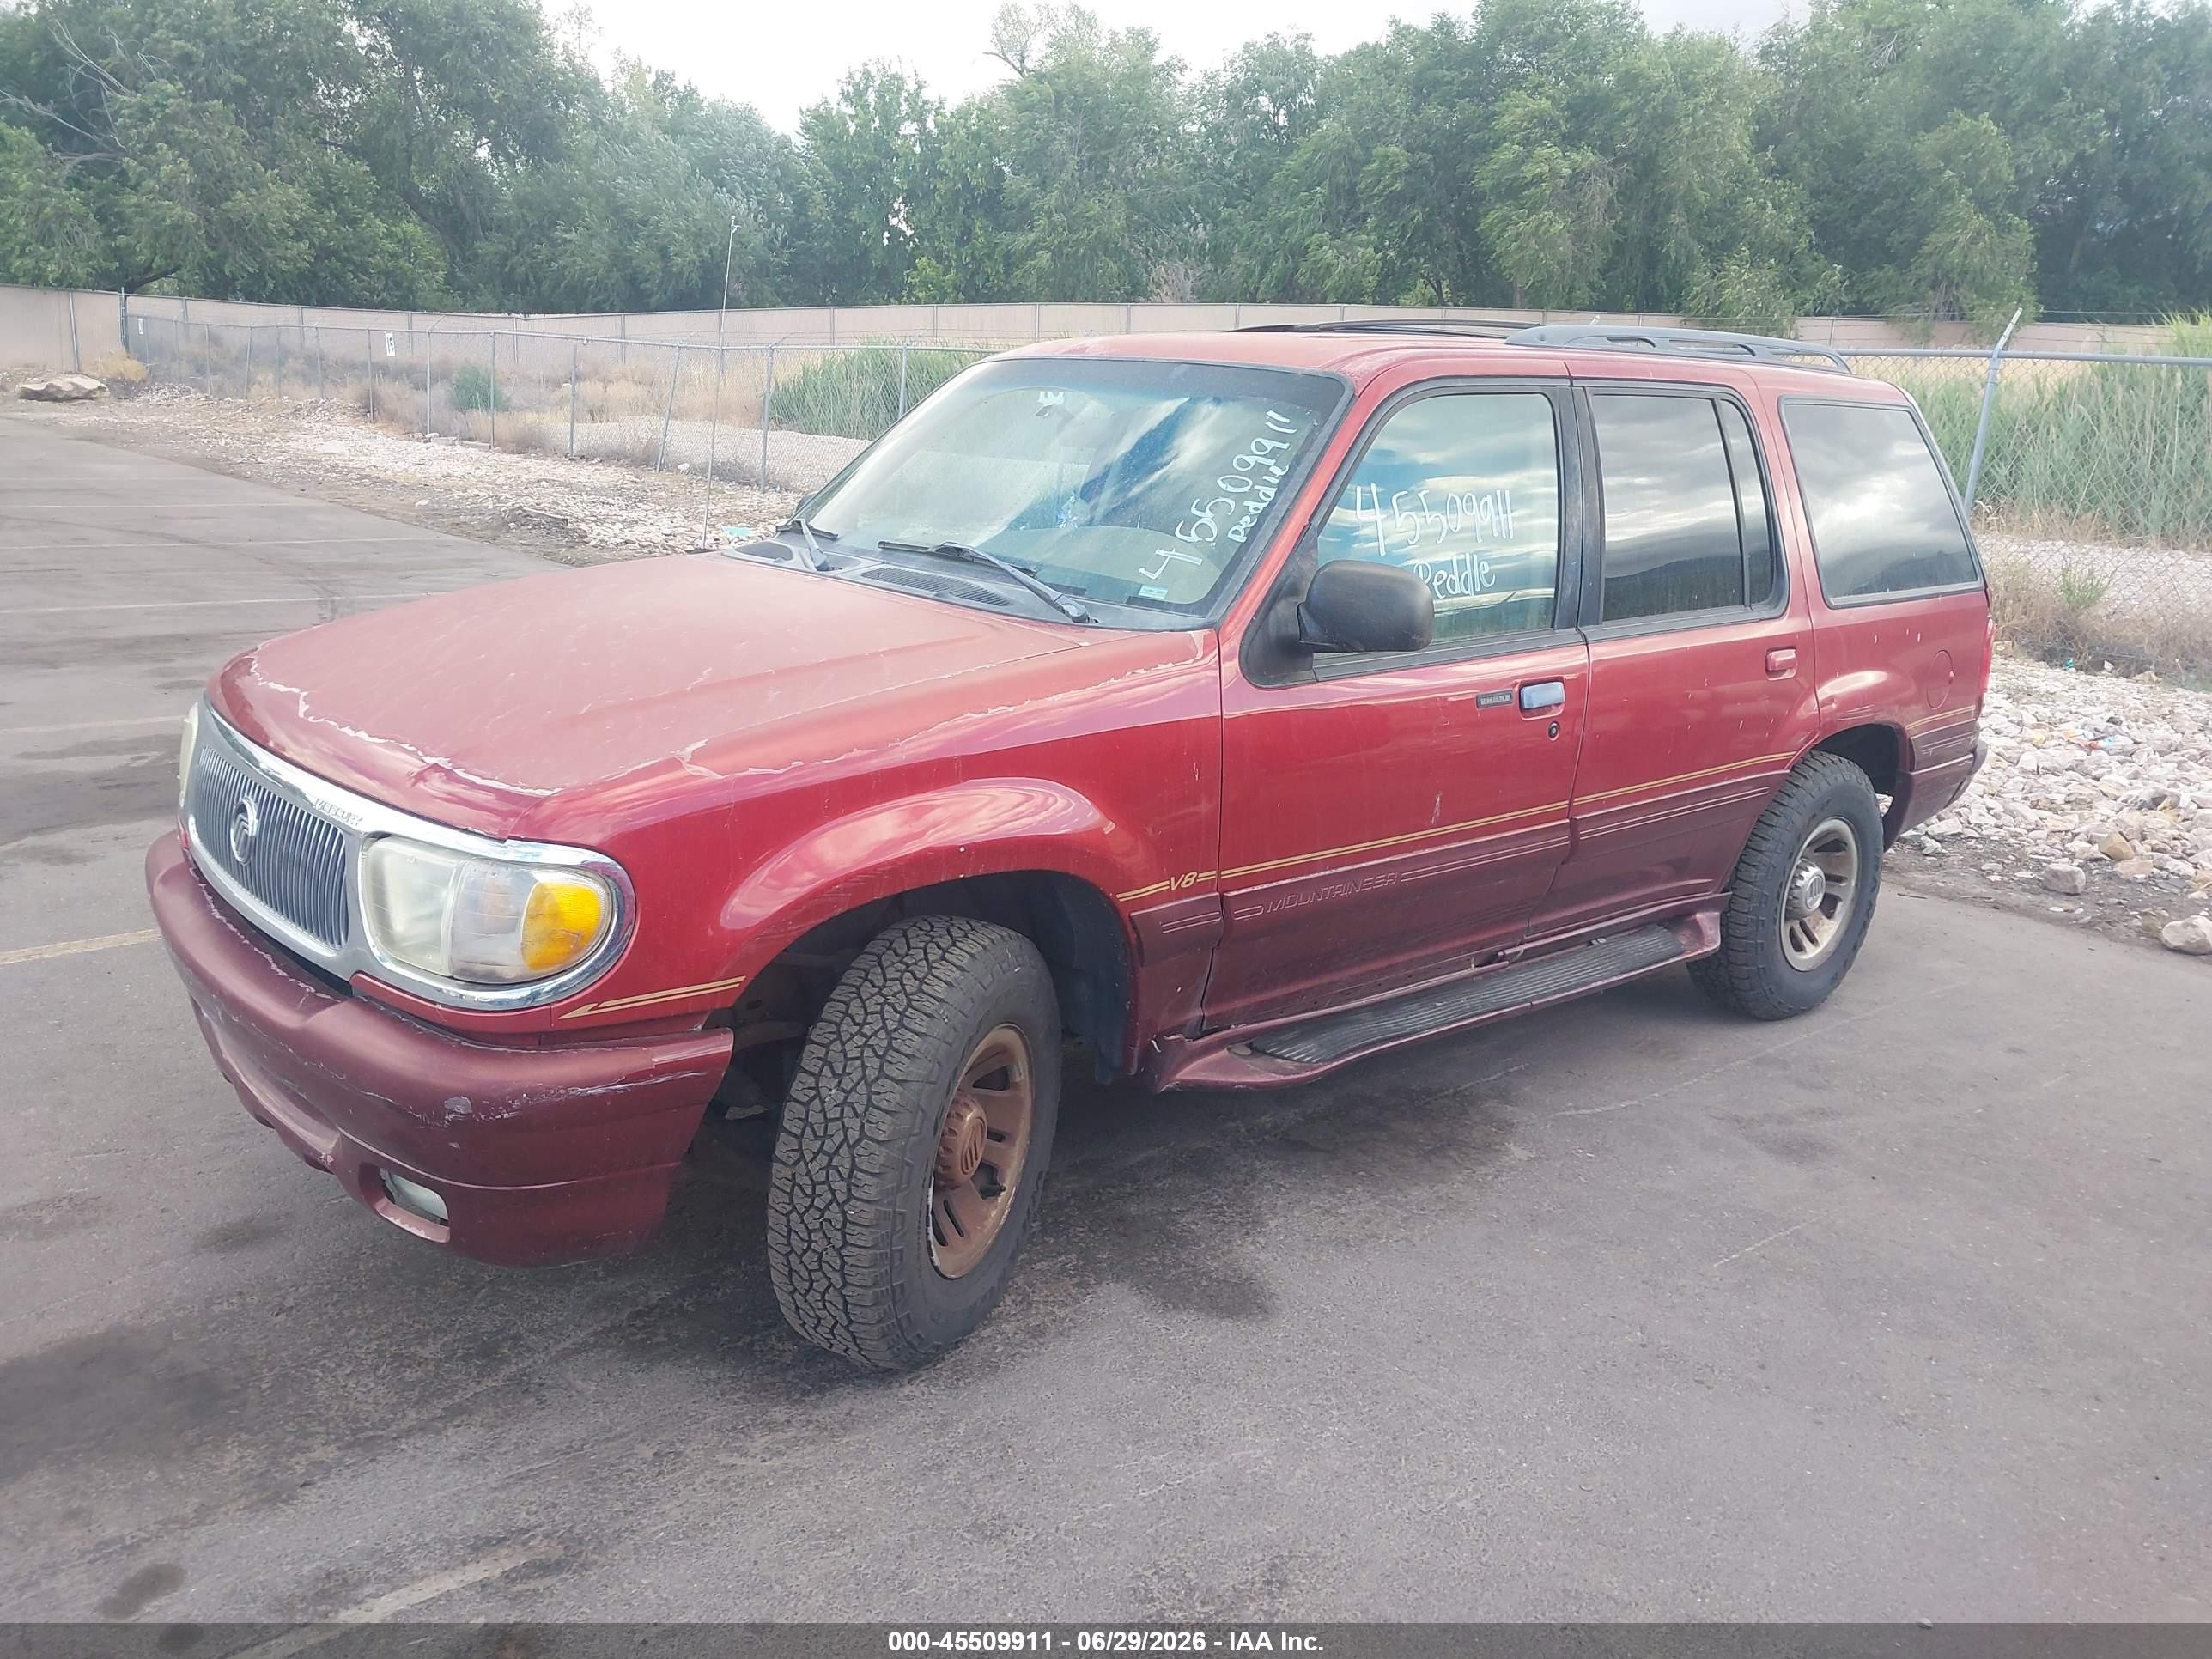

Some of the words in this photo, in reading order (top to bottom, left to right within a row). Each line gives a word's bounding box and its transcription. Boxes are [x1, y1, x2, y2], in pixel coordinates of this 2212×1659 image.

[1139, 410, 1297, 580] 45509911
[1356, 483, 1514, 556] 45509911
[1413, 552, 1496, 599] Peddle
[315, 797, 365, 827] MERCURY
[1169, 872, 1198, 891] V8
[1267, 872, 1398, 913] MOUNTAINEER
